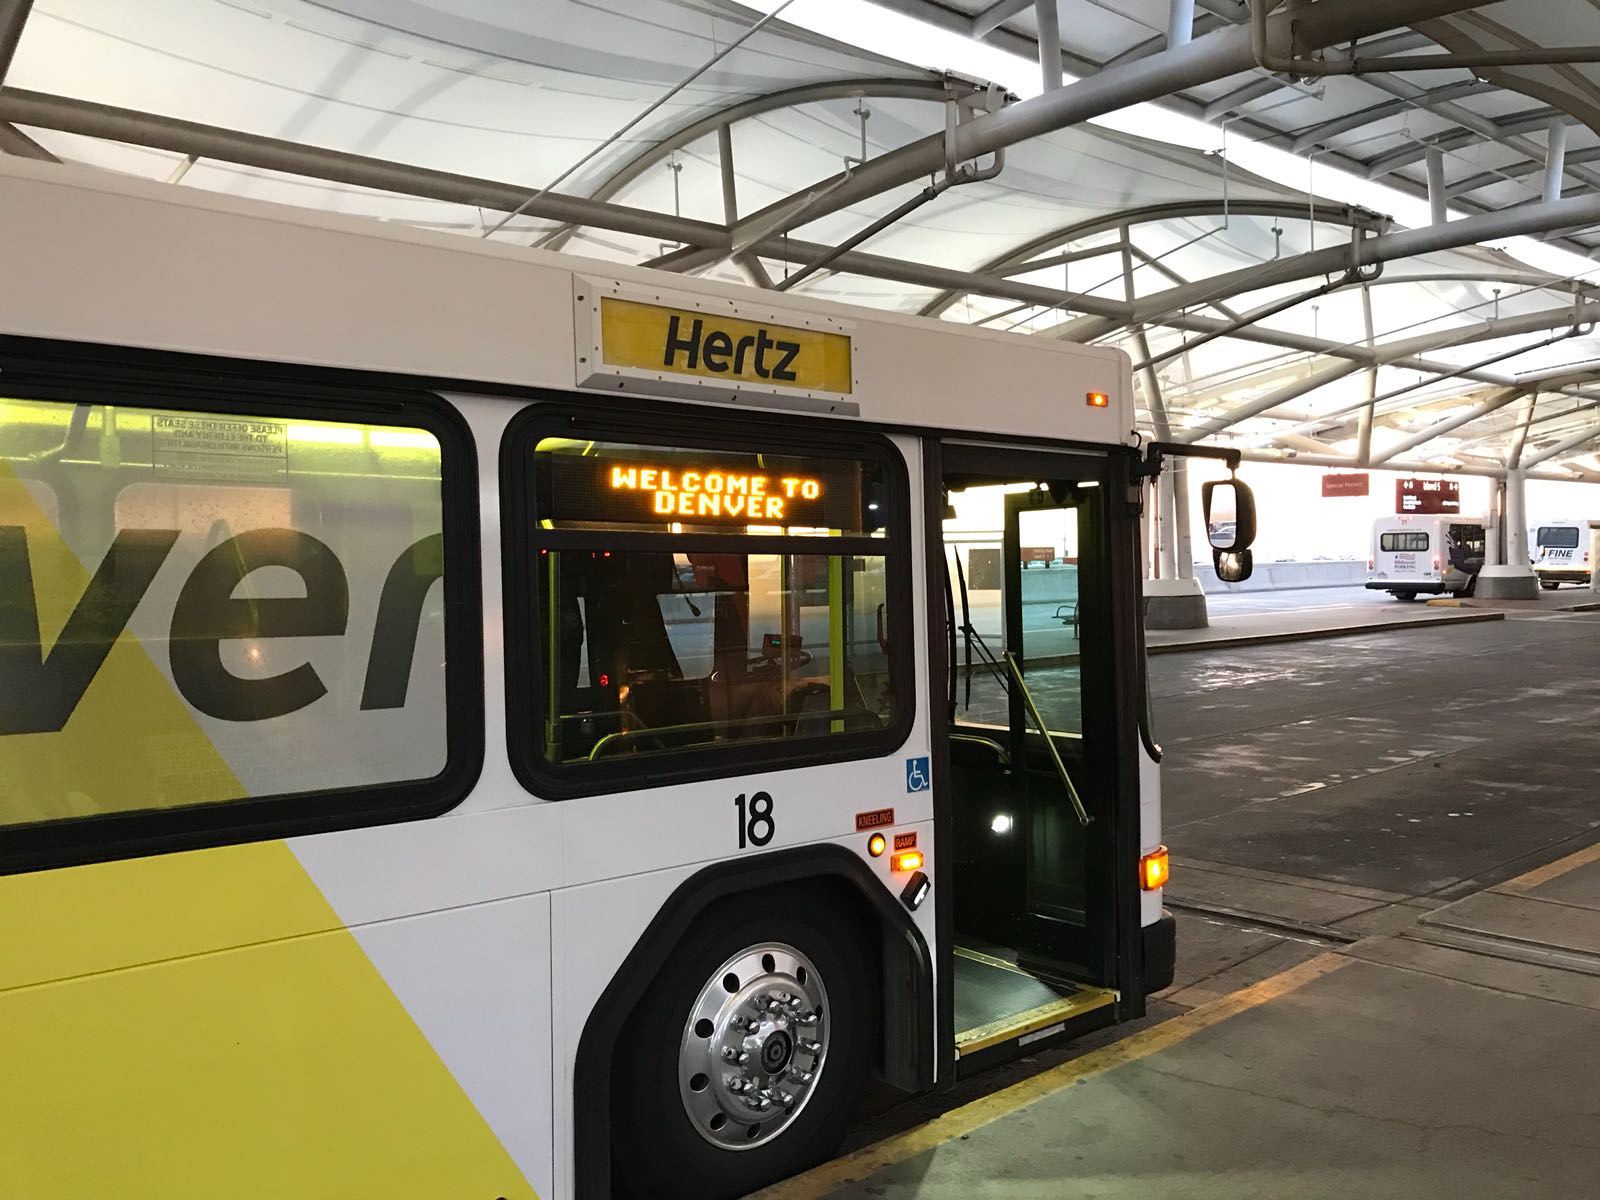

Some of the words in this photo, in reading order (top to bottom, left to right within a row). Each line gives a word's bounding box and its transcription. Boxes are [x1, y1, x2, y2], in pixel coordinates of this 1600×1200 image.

[664, 316, 800, 381] Hertz
[612, 467, 767, 496] WELCOME
[782, 478, 819, 499] TO
[655, 491, 784, 519] DENVER
[1548, 549, 1574, 558] FINE
[734, 791, 775, 849] 18
[858, 812, 892, 828] KNEELING
[895, 835, 915, 848] RAMP
